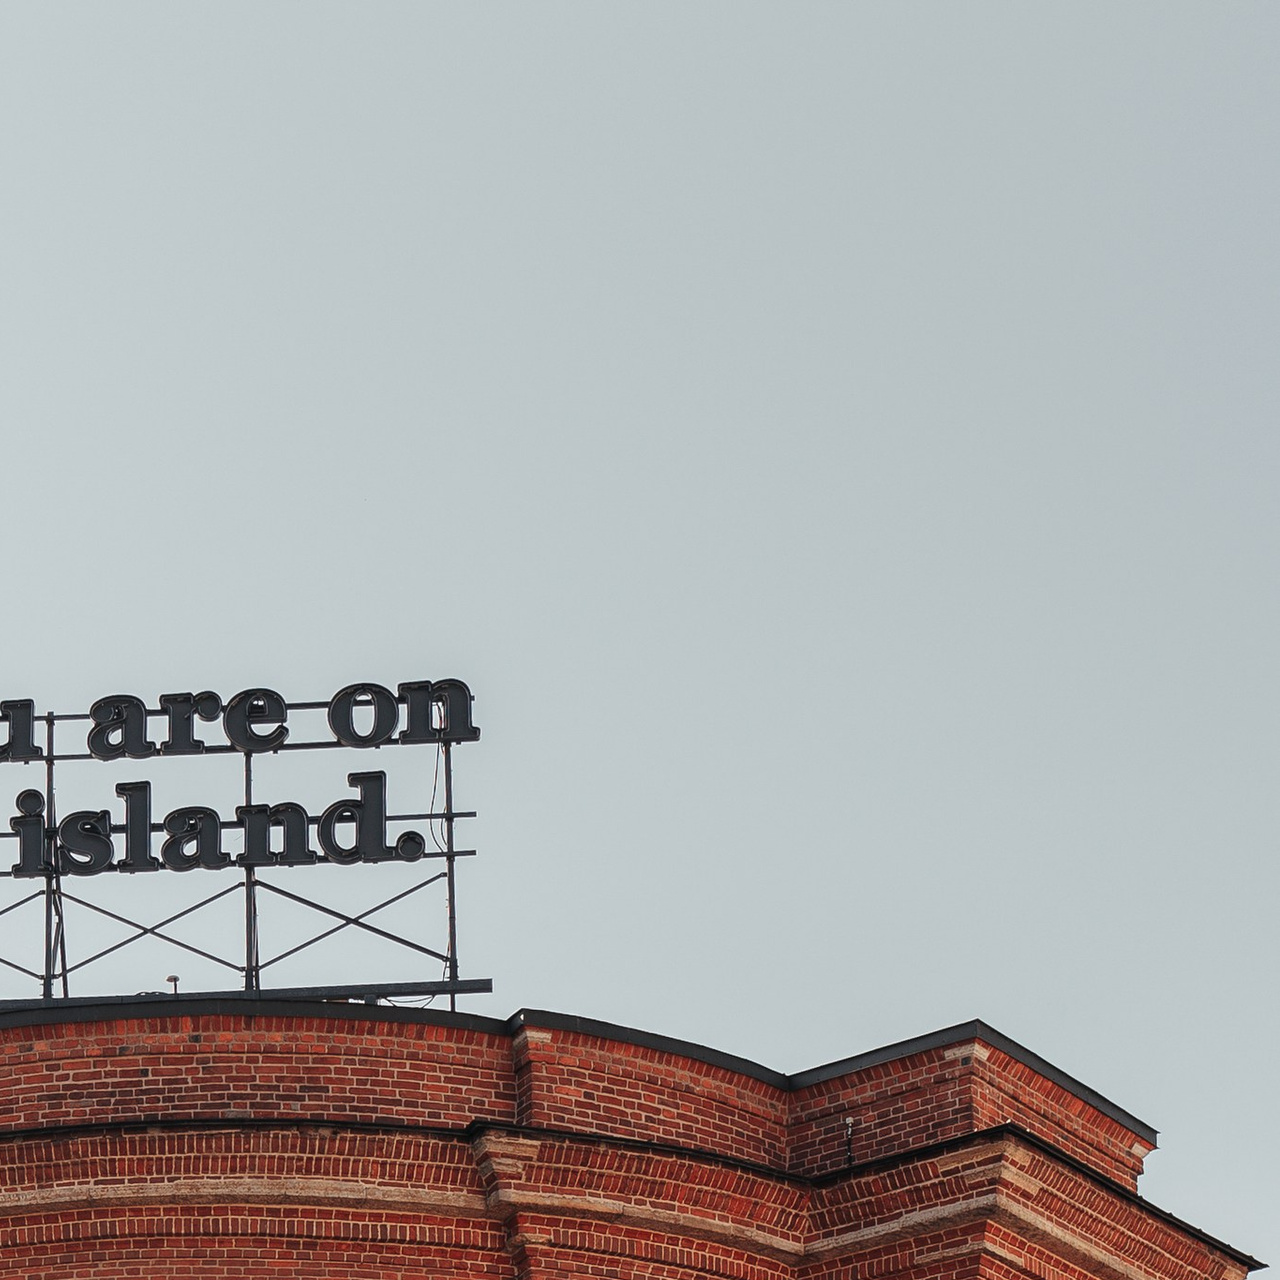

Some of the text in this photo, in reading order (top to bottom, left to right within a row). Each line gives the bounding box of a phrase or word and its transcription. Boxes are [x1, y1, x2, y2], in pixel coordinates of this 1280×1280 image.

[88, 688, 289, 761] are
[328, 678, 480, 748] on
[10, 770, 425, 878] island.
